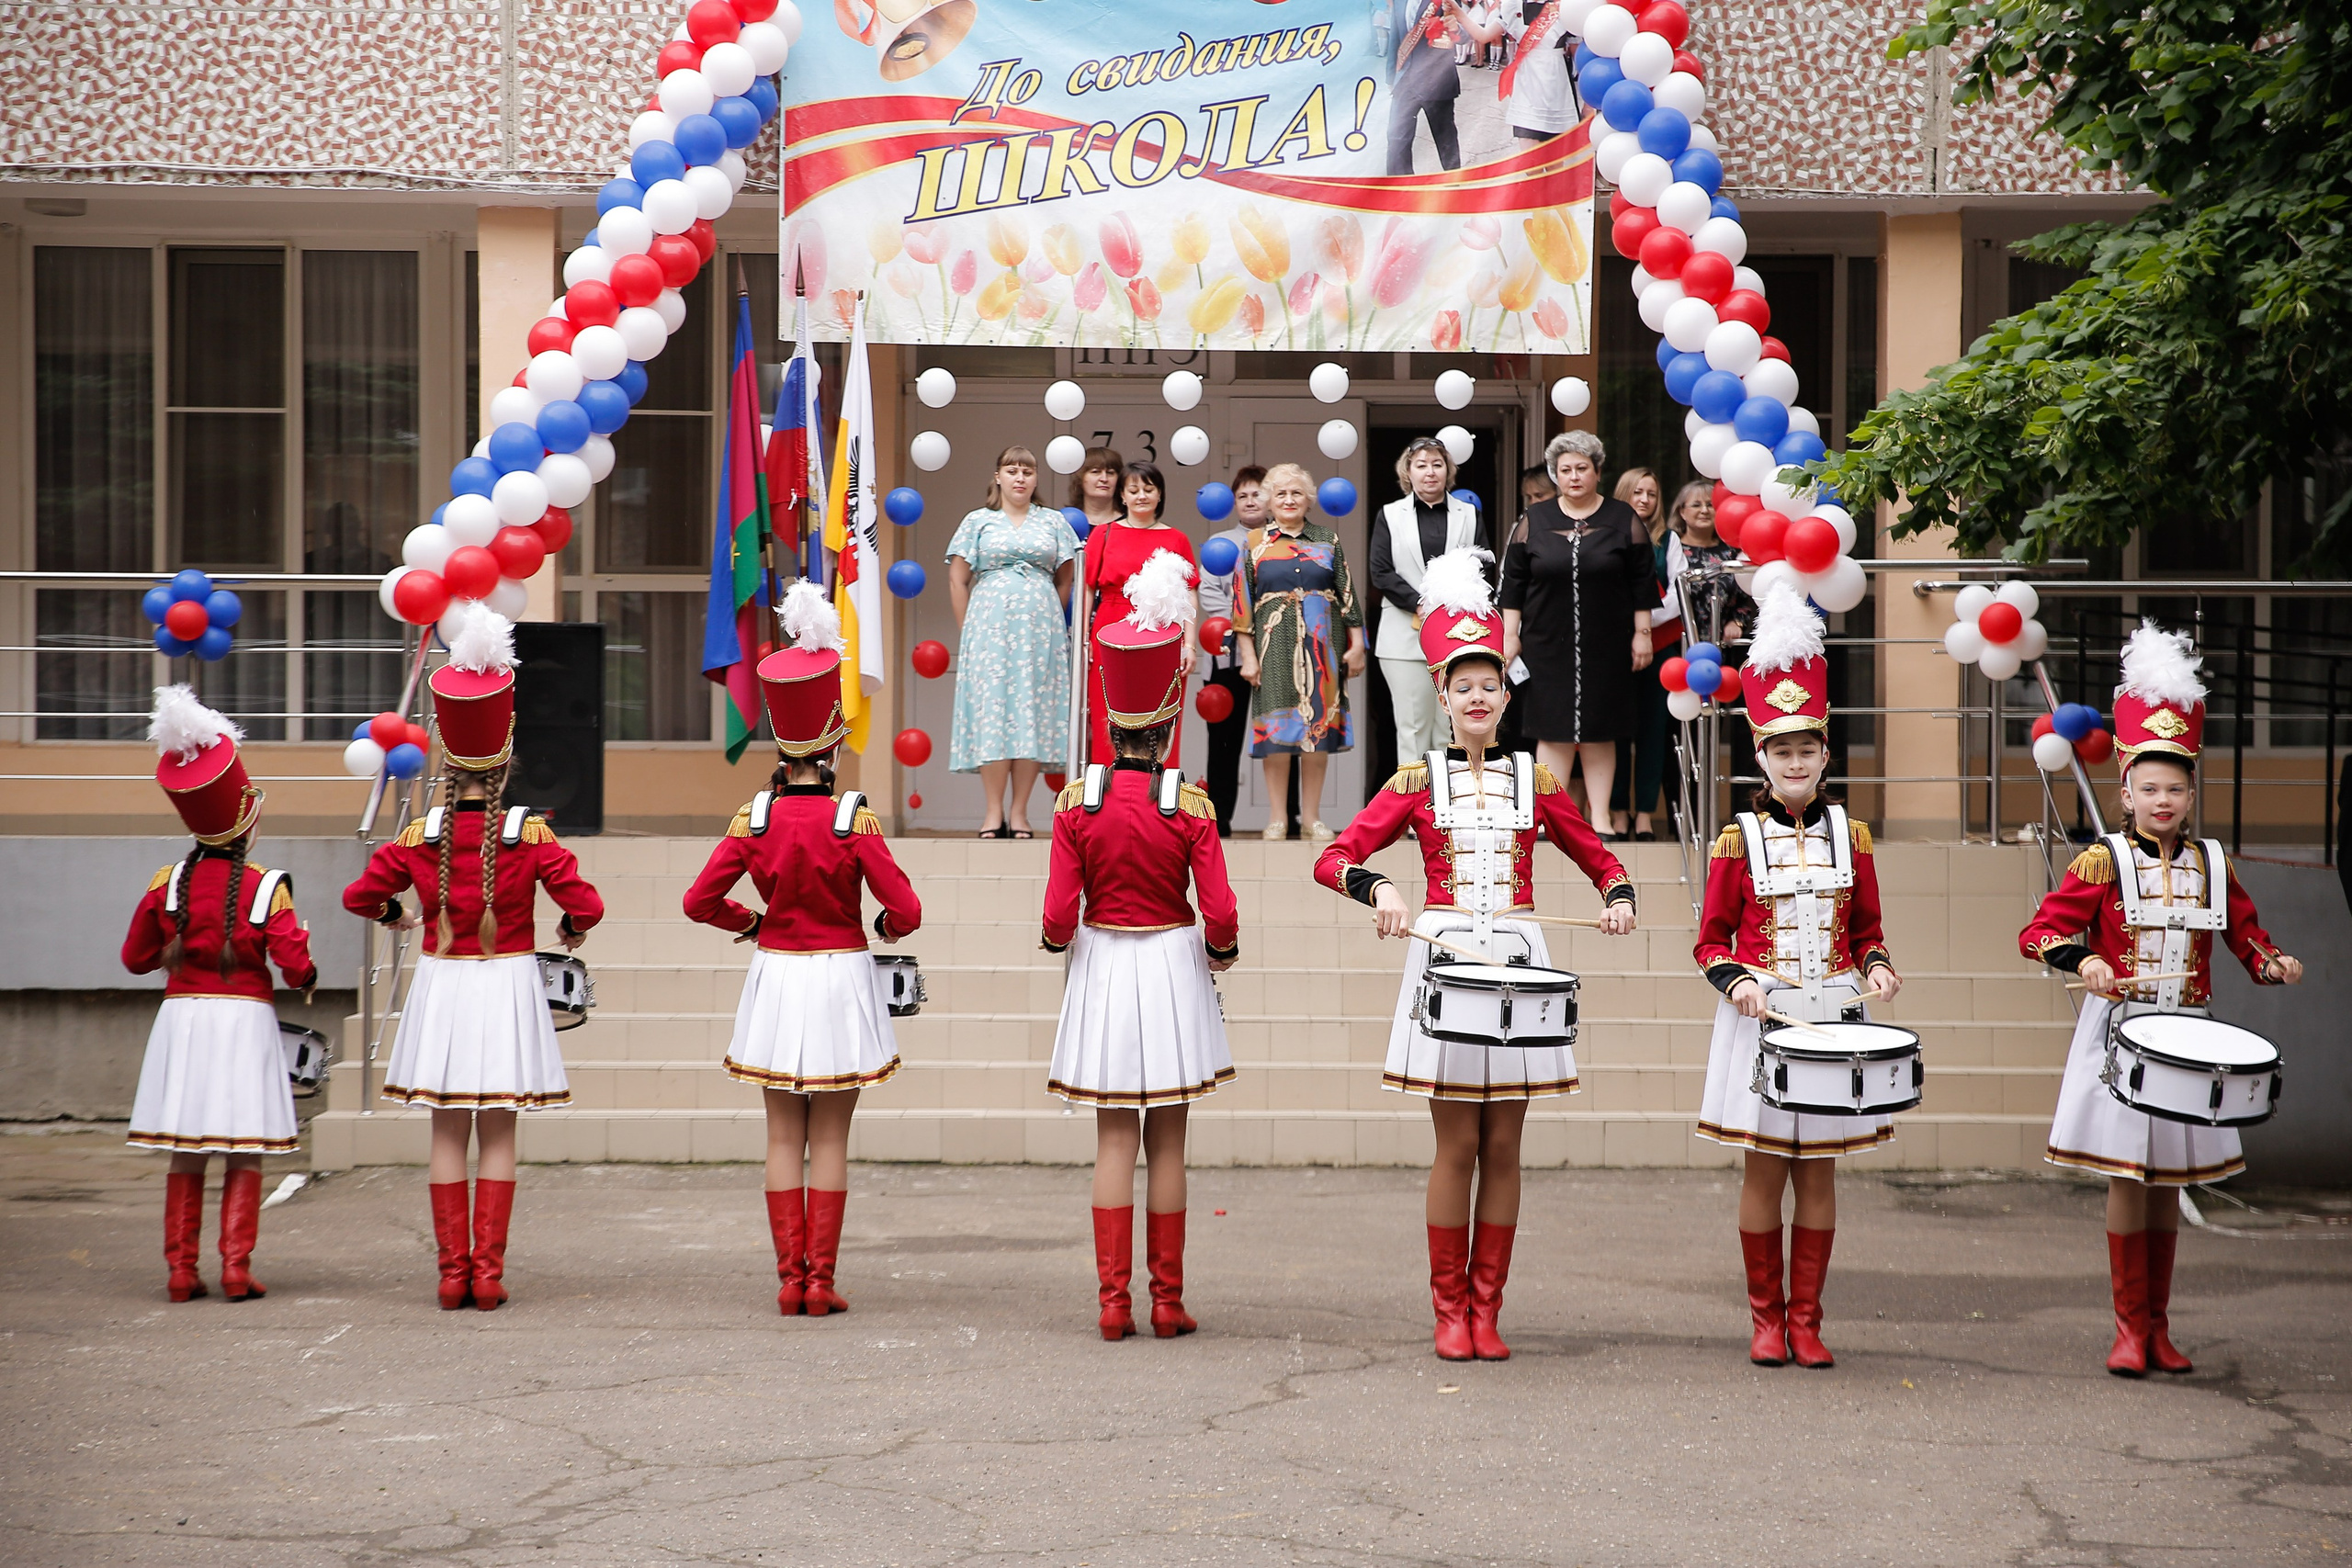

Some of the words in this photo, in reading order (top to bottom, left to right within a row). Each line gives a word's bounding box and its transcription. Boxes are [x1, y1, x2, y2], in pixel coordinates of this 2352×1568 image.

[949, 58, 1043, 126] До
[1066, 22, 1342, 96] свидания,
[903, 76, 1376, 224] ШКОЛА!
